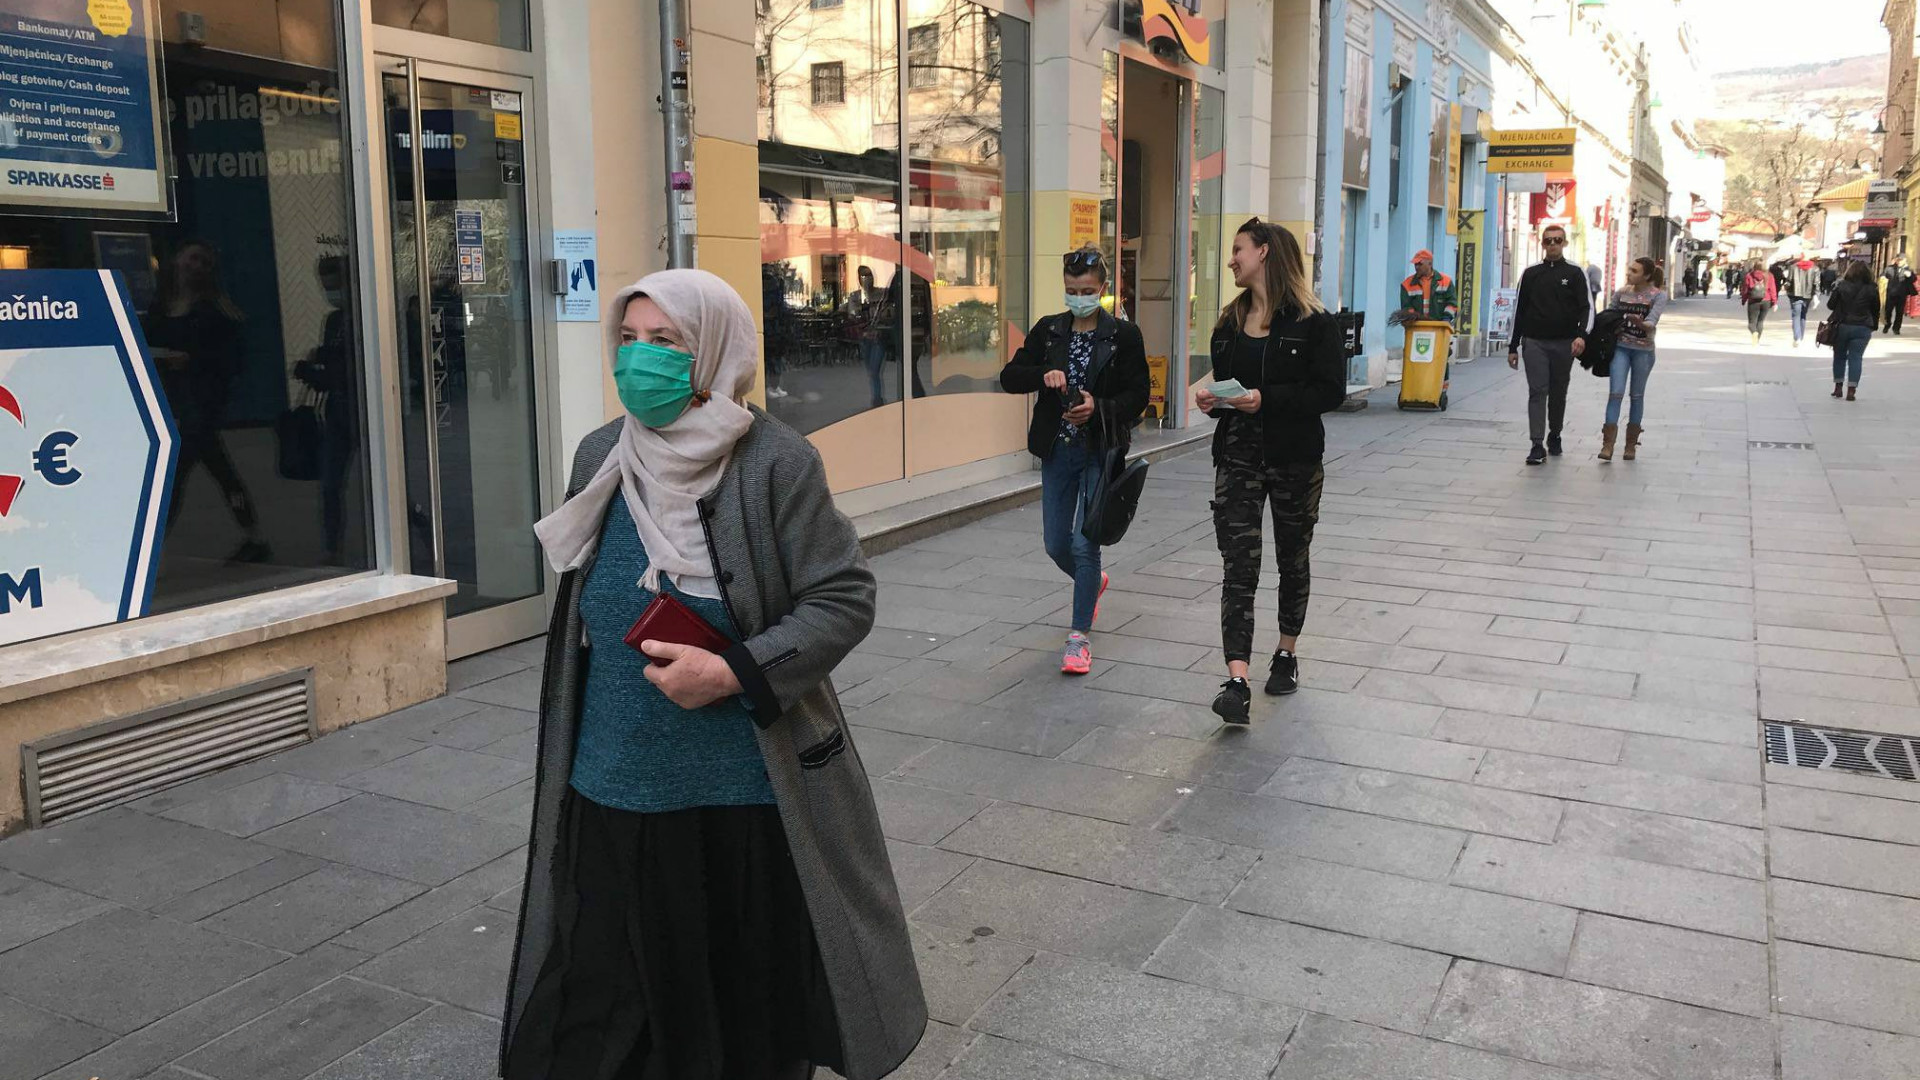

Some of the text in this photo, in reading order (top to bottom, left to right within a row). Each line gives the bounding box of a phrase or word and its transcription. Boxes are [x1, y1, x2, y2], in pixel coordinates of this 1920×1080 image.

[17, 21, 95, 41] Bankomat/ATM
[20, 74, 93, 91] gotovine/Cash
[95, 82, 130, 95] deposit
[9, 98, 41, 110] Ovjera
[50, 104, 81, 115] prijem
[83, 107, 116, 119] naloga
[44, 117, 62, 126] and
[65, 119, 120, 132] acceptance
[13, 127, 102, 144] of payment orders
[1505, 160, 1554, 168] EXCHANGE
[7, 169, 102, 190] SPARKASSE
[1463, 246, 1473, 315] EXCHANGE
[0, 294, 79, 320] ačnica
